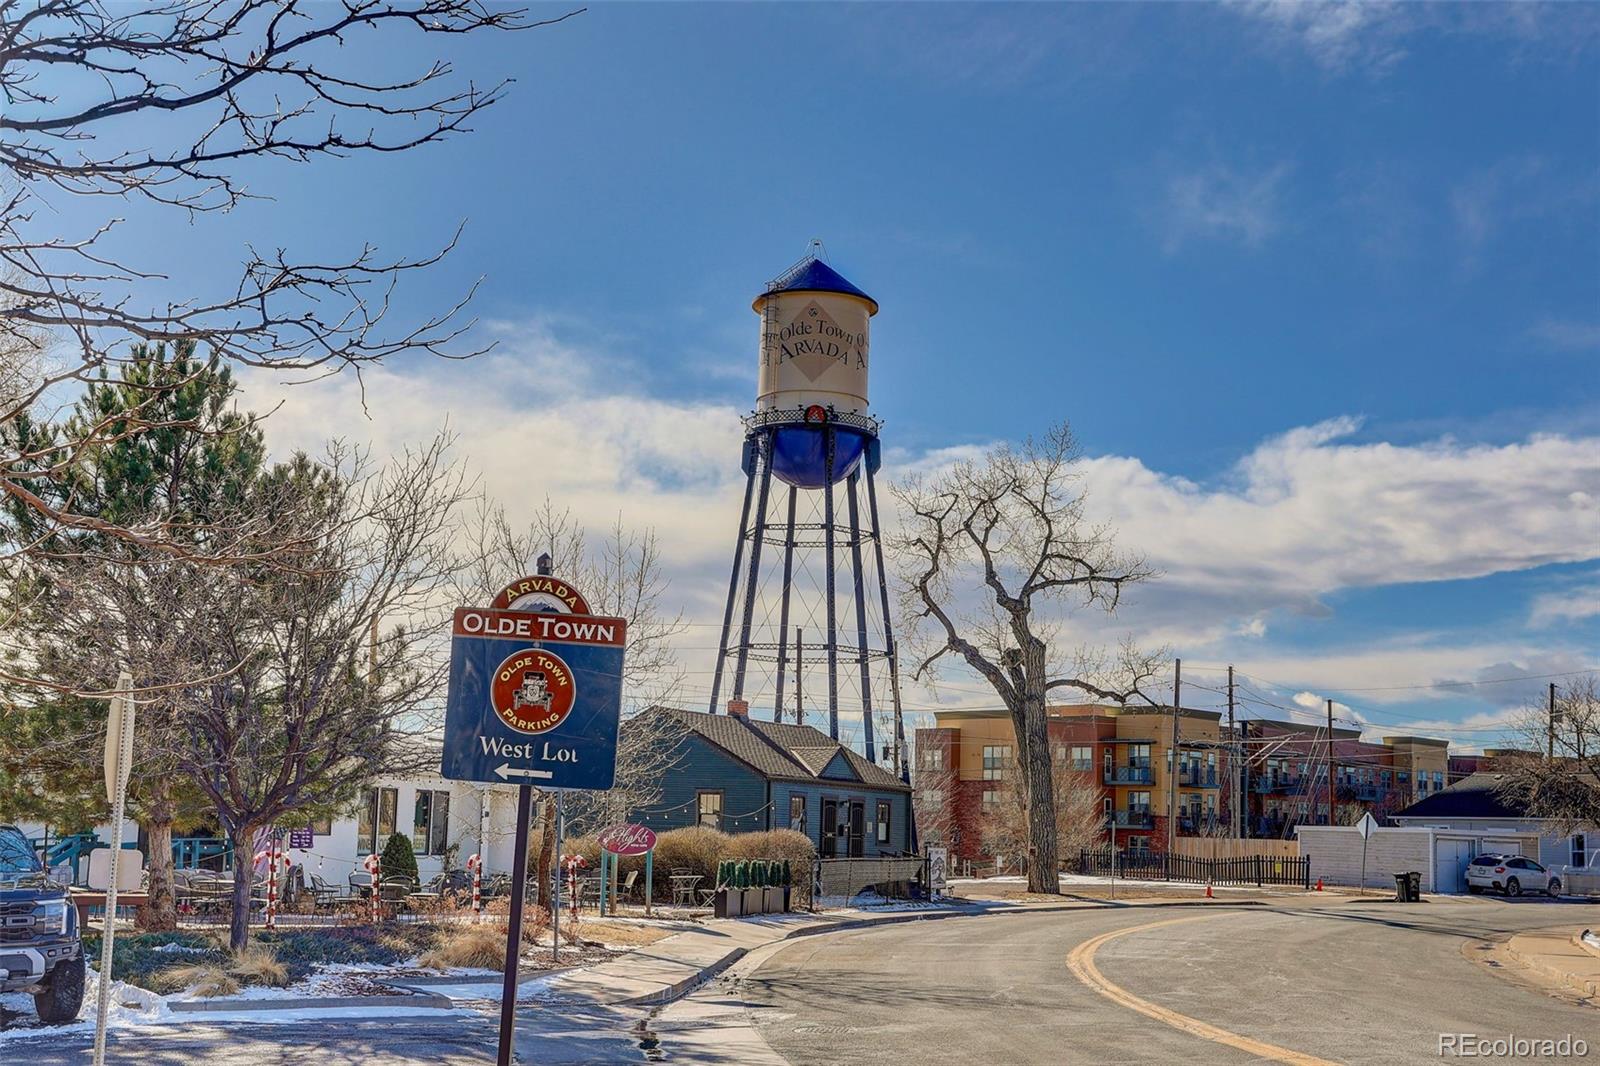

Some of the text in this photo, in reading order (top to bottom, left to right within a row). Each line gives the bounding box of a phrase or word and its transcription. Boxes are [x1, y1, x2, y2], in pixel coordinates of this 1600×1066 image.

[780, 322, 812, 341] Olde
[816, 320, 853, 345] Town
[779, 339, 849, 366] ARVADA
[506, 580, 578, 608] ARVADA
[463, 613, 615, 642] OLDE TOWN
[500, 656, 568, 686] OLDE TOWN
[503, 708, 559, 730] PARKING
[480, 736, 533, 759] West
